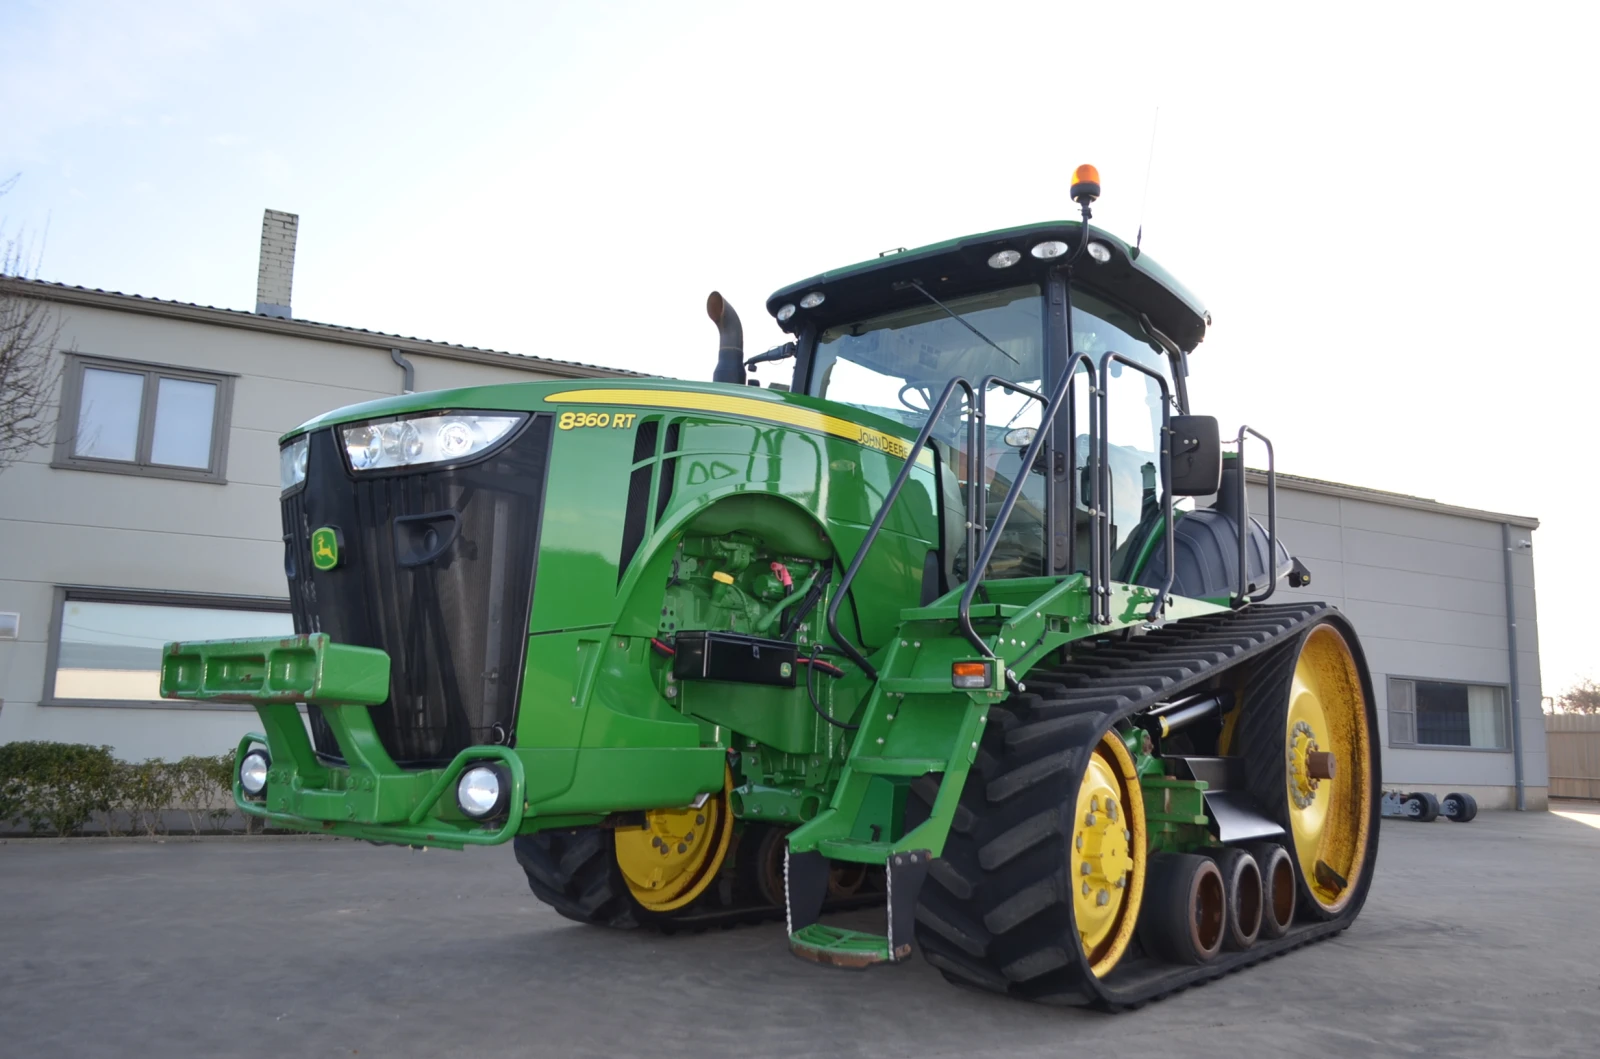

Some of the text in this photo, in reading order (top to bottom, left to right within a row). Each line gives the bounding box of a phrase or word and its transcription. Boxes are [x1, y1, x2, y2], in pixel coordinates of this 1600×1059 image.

[558, 412, 636, 430] 8360 RT
[857, 428, 909, 458] JOHN DEERE
